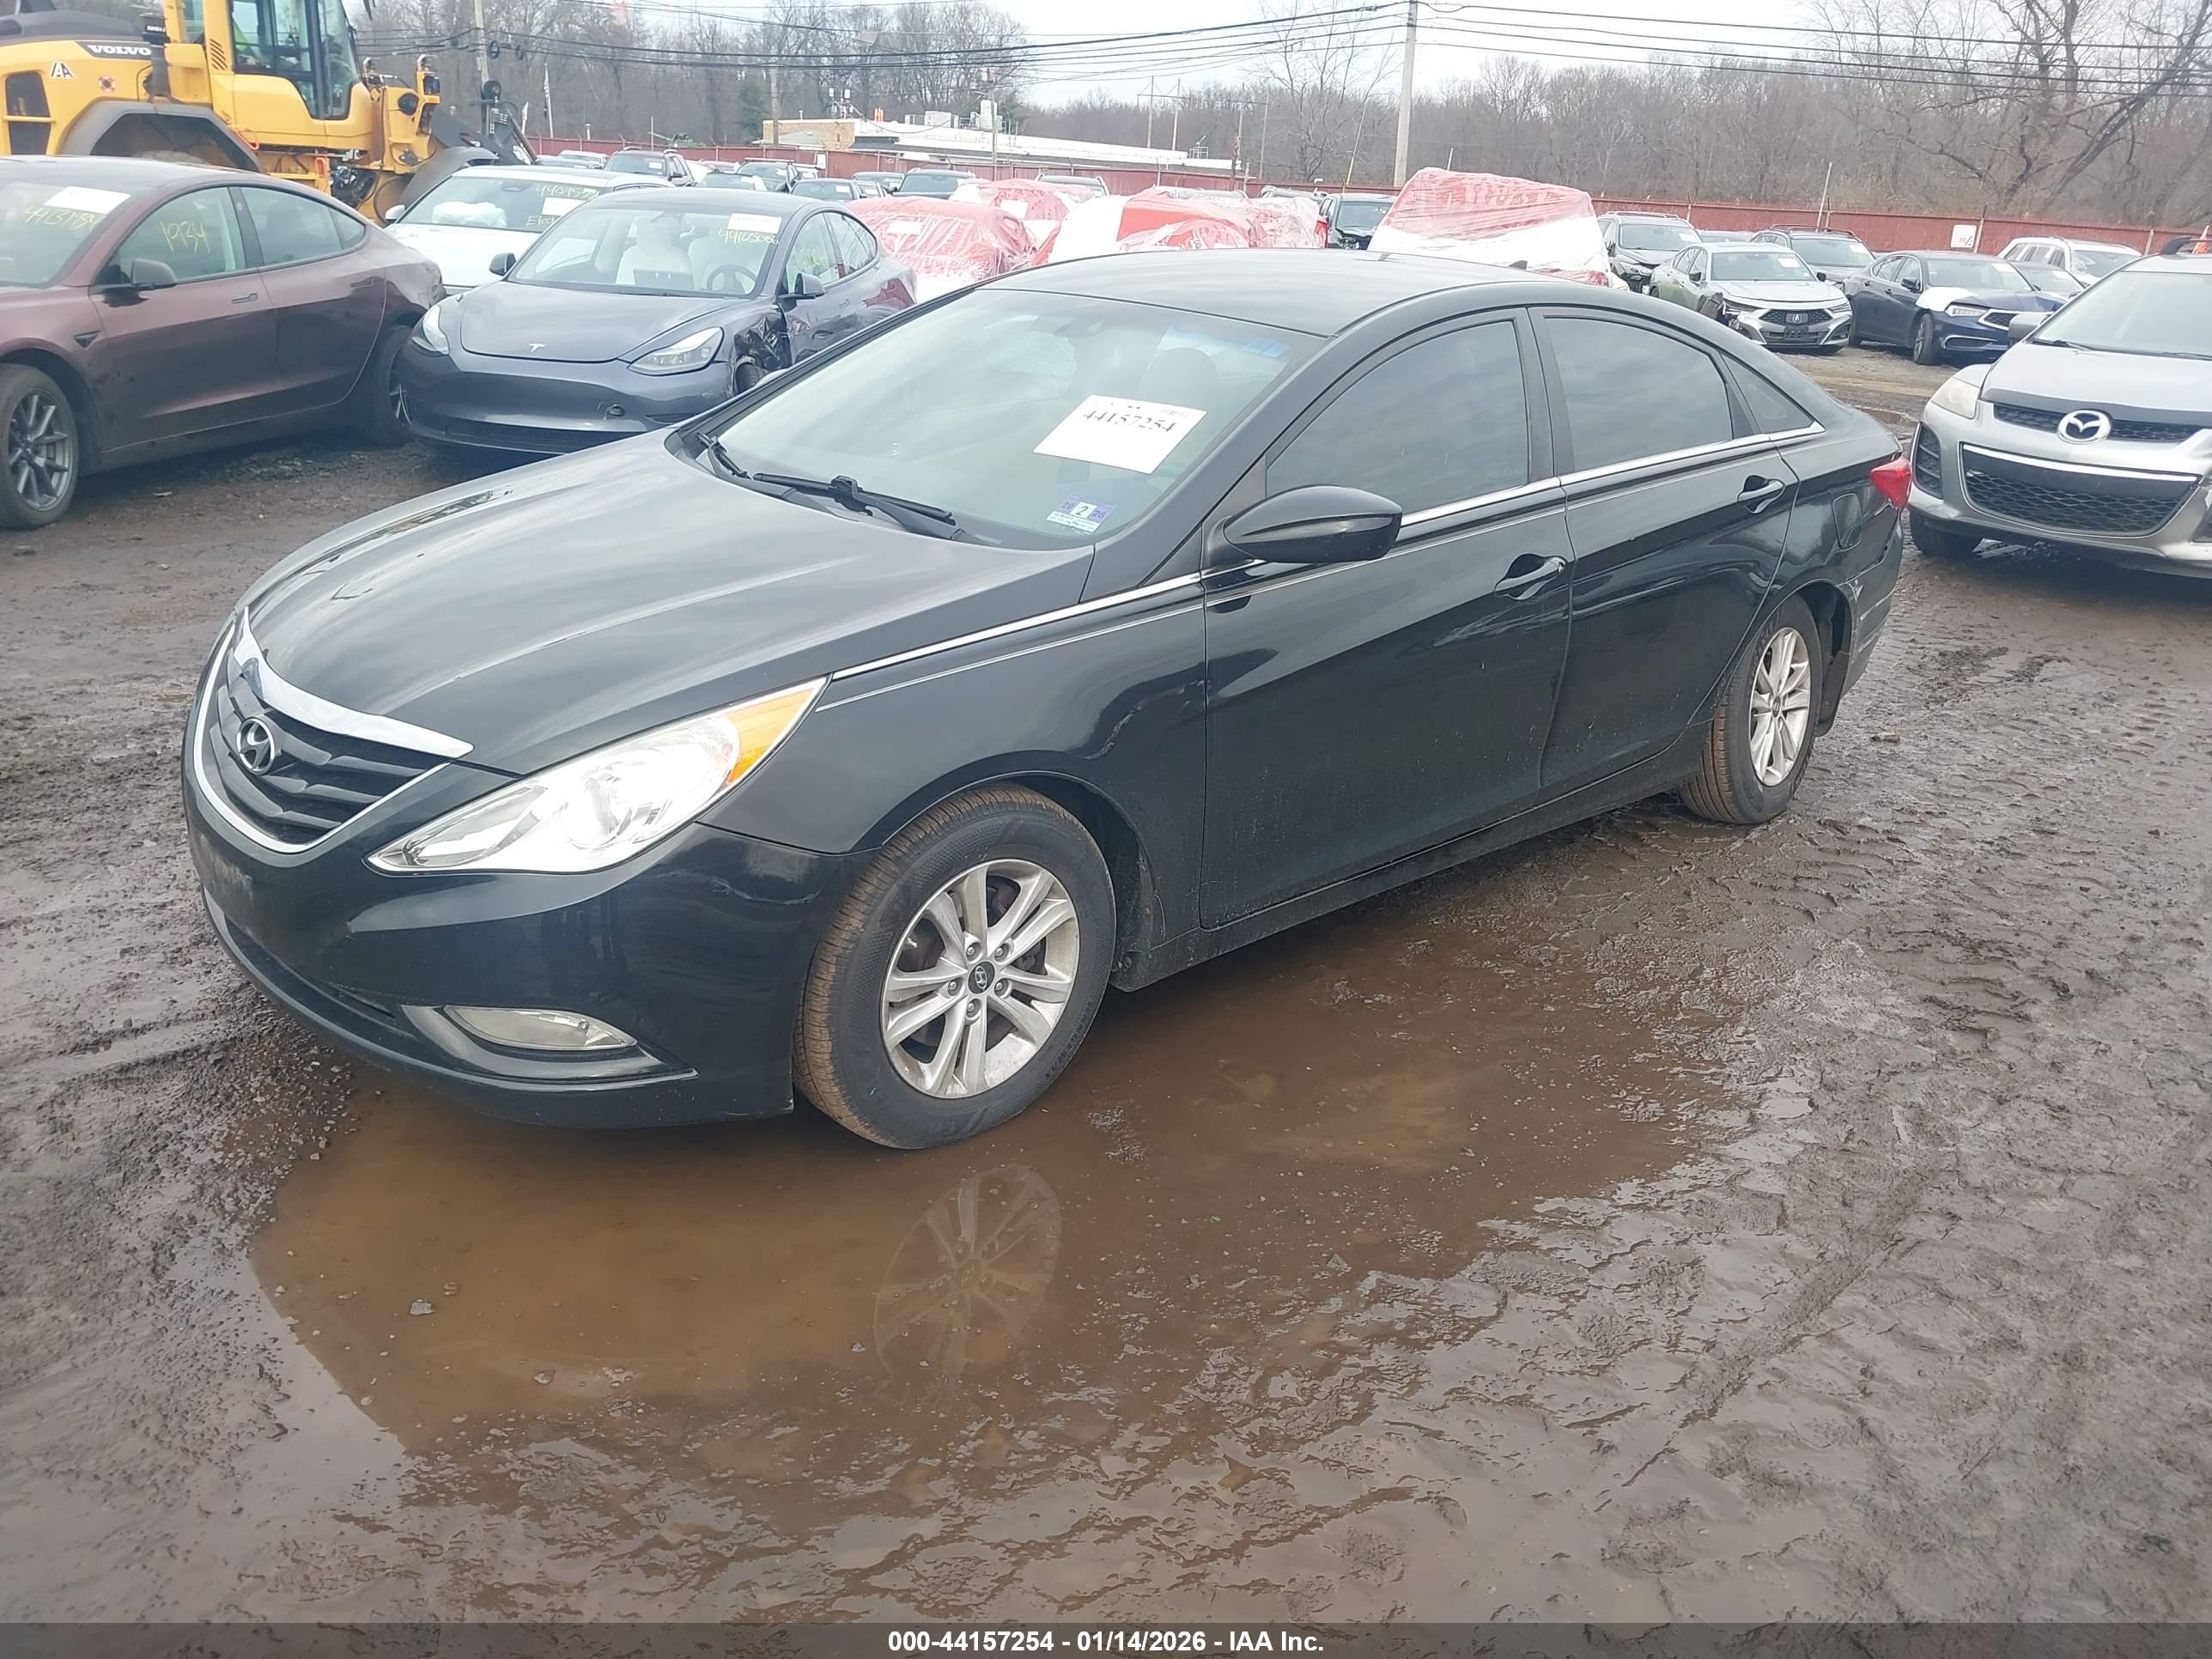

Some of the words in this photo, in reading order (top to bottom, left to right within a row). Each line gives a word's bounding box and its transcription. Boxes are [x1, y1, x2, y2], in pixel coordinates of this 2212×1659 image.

[87, 45, 152, 56] VOLVO
[159, 219, 211, 255] 1934
[1083, 410, 1177, 432] 44157254
[1075, 505, 1090, 516] 2
